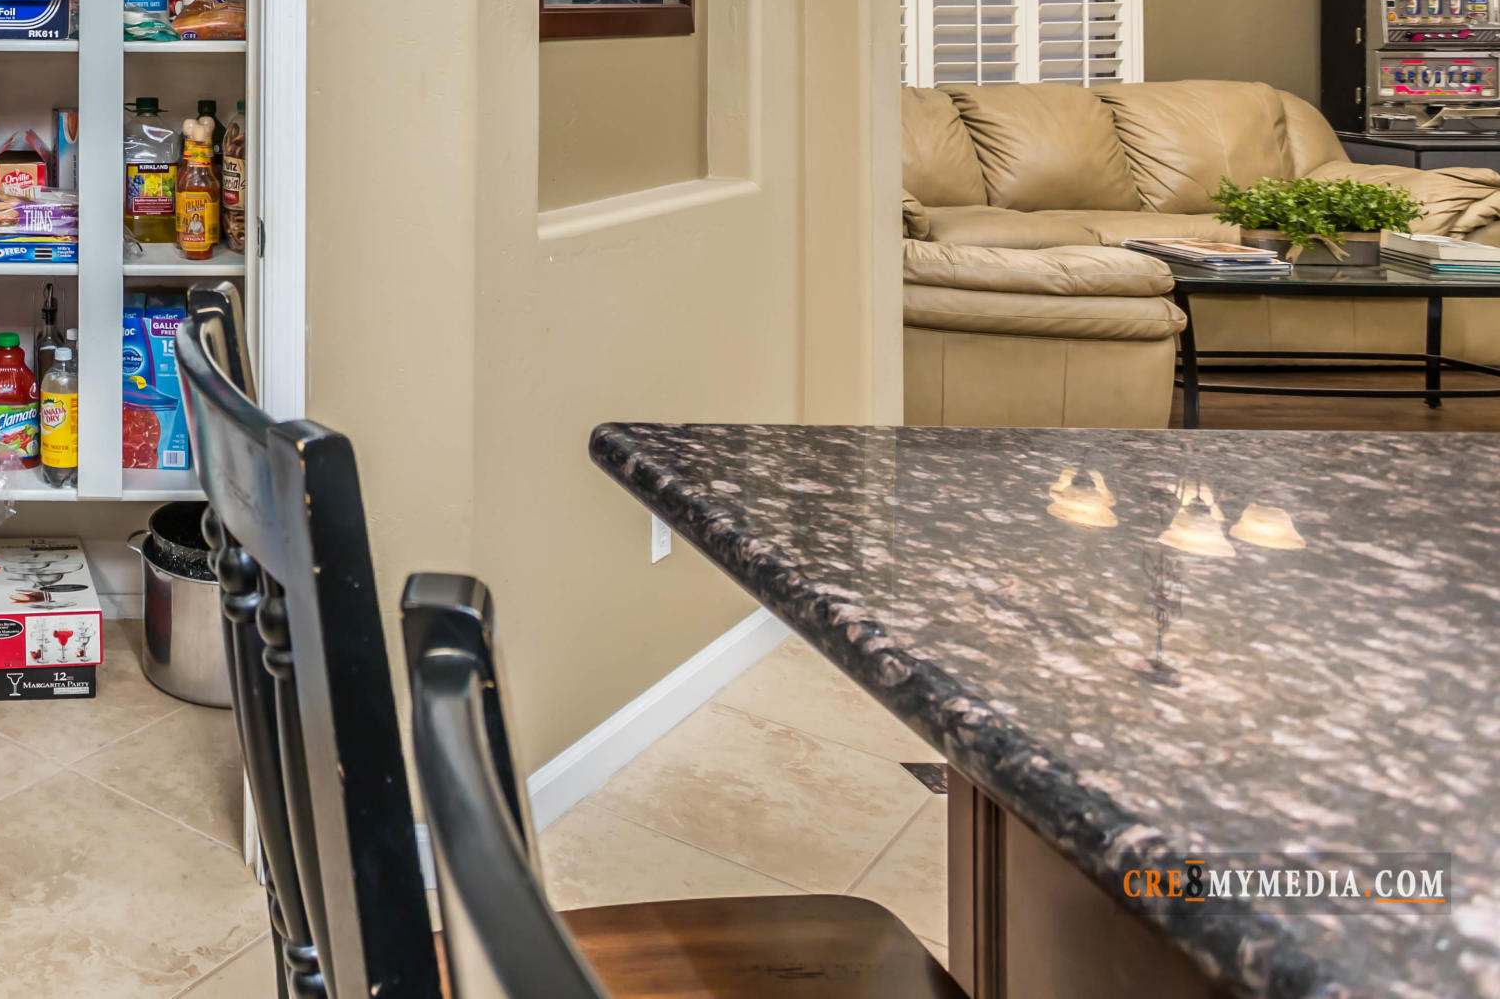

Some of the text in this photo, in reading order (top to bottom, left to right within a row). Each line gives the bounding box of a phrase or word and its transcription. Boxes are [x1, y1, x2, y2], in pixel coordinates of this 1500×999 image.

[29, 30, 59, 38] RK611
[5, 172, 30, 183] Orville
[24, 210, 53, 232] THINS
[153, 322, 179, 330] GALLO
[53, 672, 67, 681] 12
